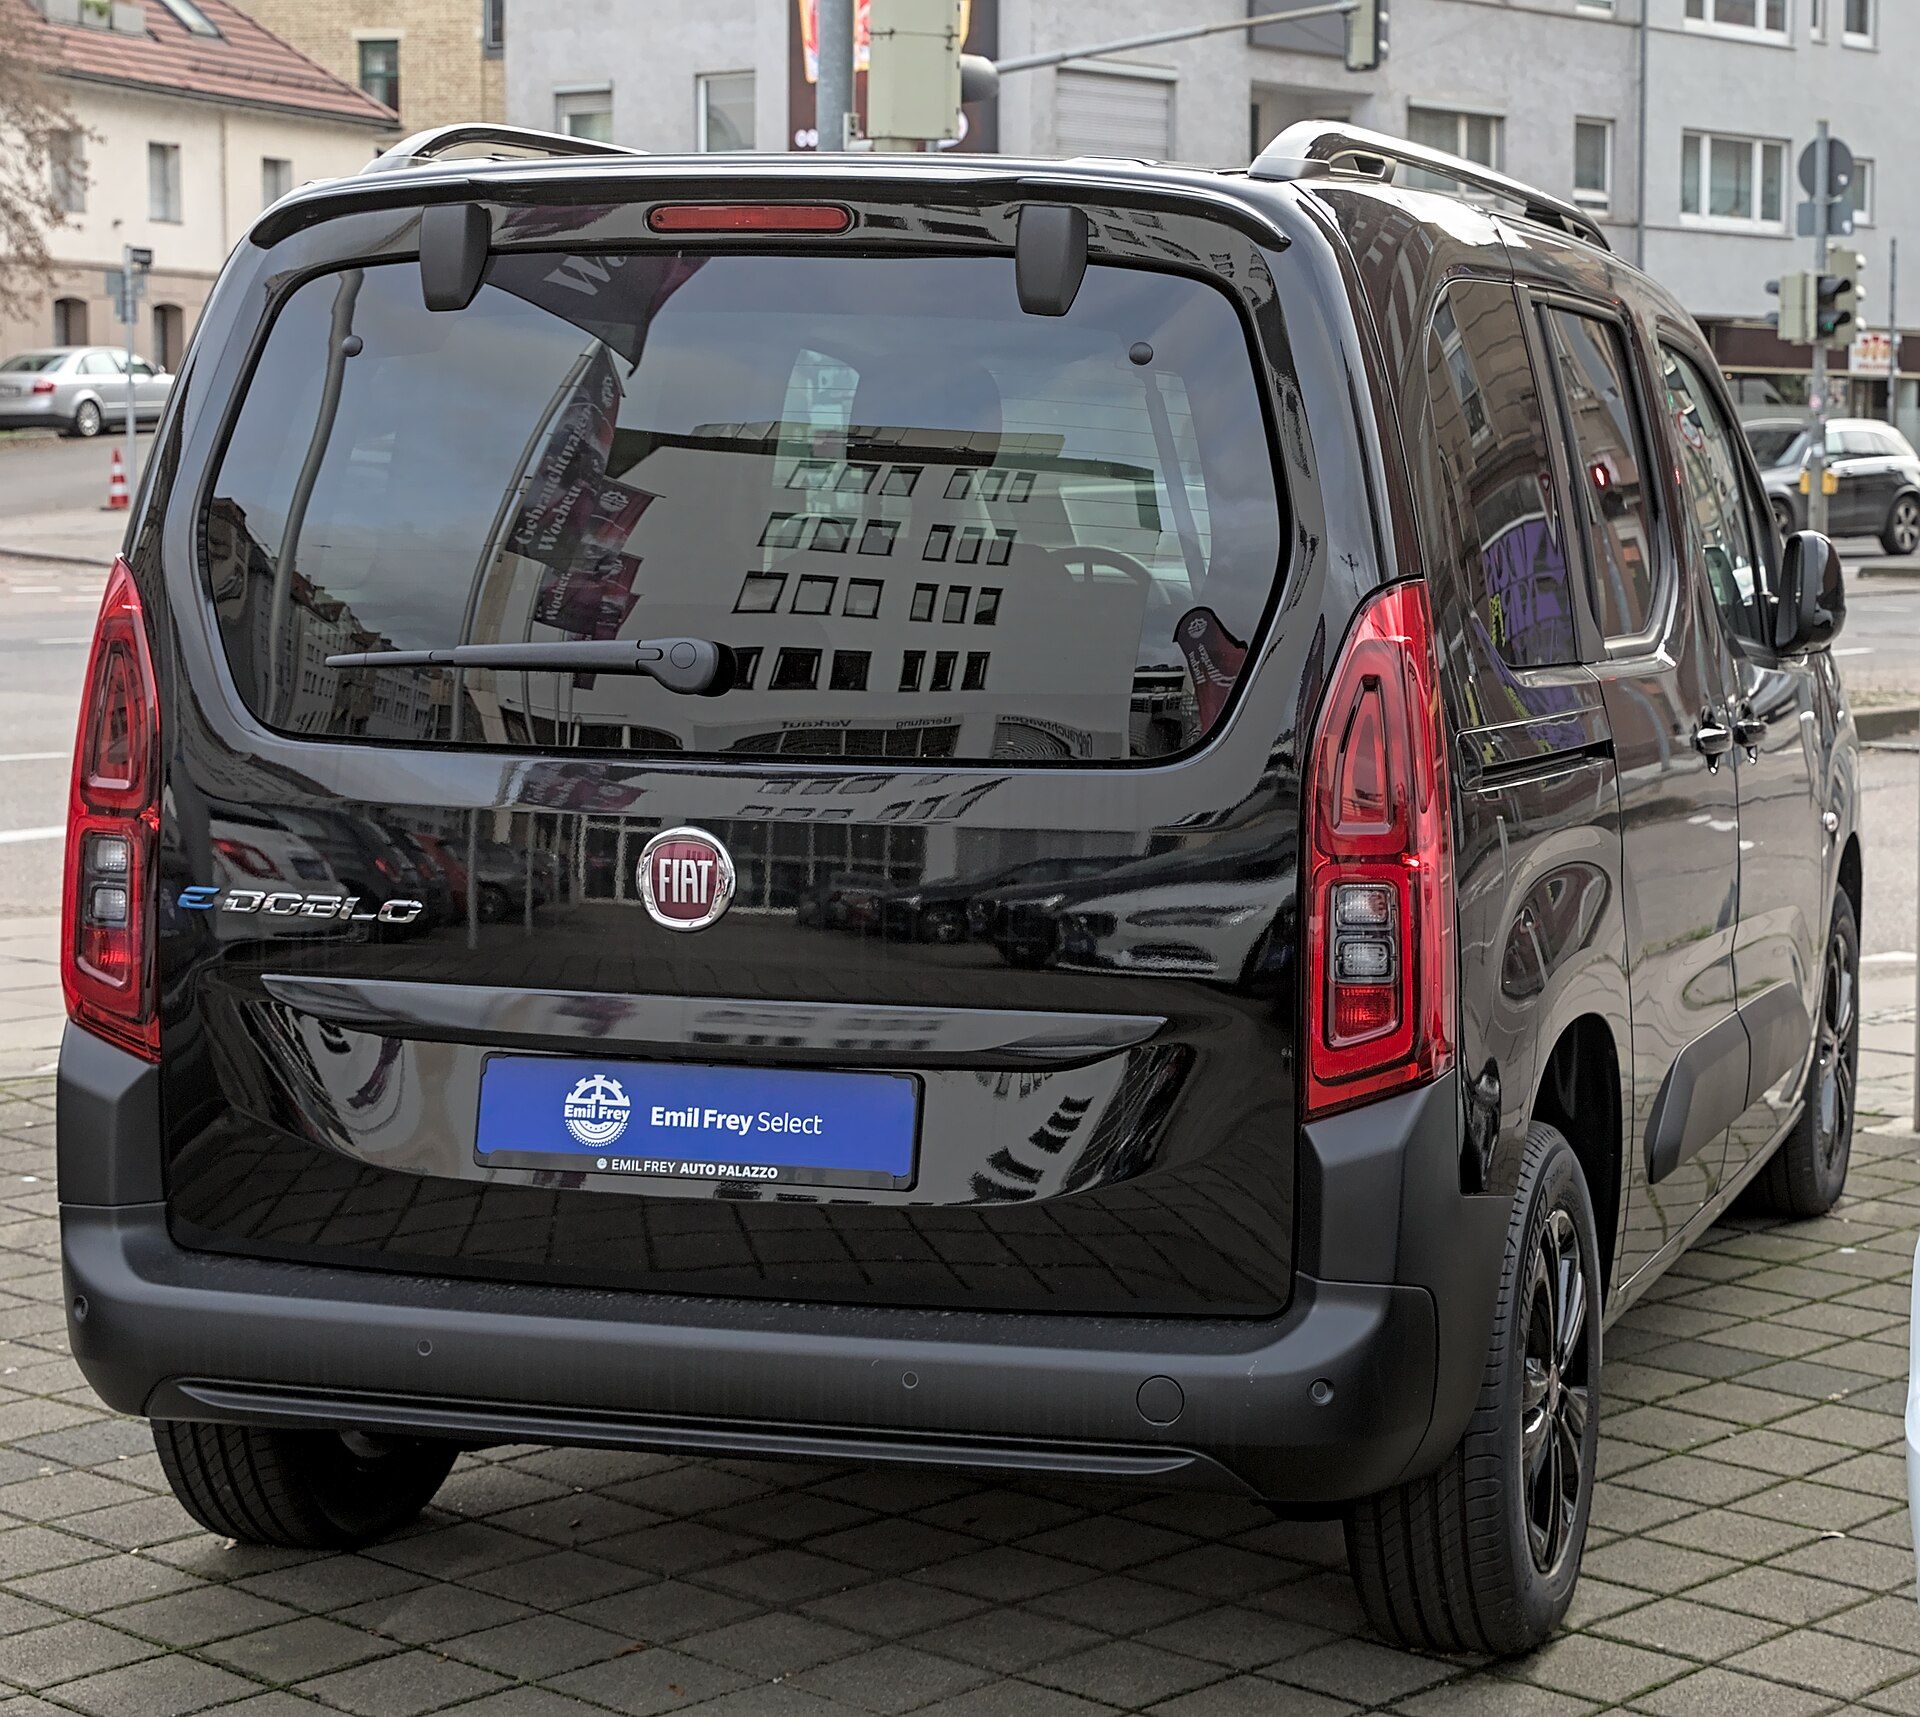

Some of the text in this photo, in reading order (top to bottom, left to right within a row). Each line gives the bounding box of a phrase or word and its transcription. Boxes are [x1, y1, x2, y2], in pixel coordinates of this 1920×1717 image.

[659, 858, 714, 904] FIAT
[564, 1104, 631, 1123] Emil Frey
[650, 1106, 823, 1136] Emil Frey Select
[611, 1158, 778, 1180] EMIL FREY AUTO PALAZZO
